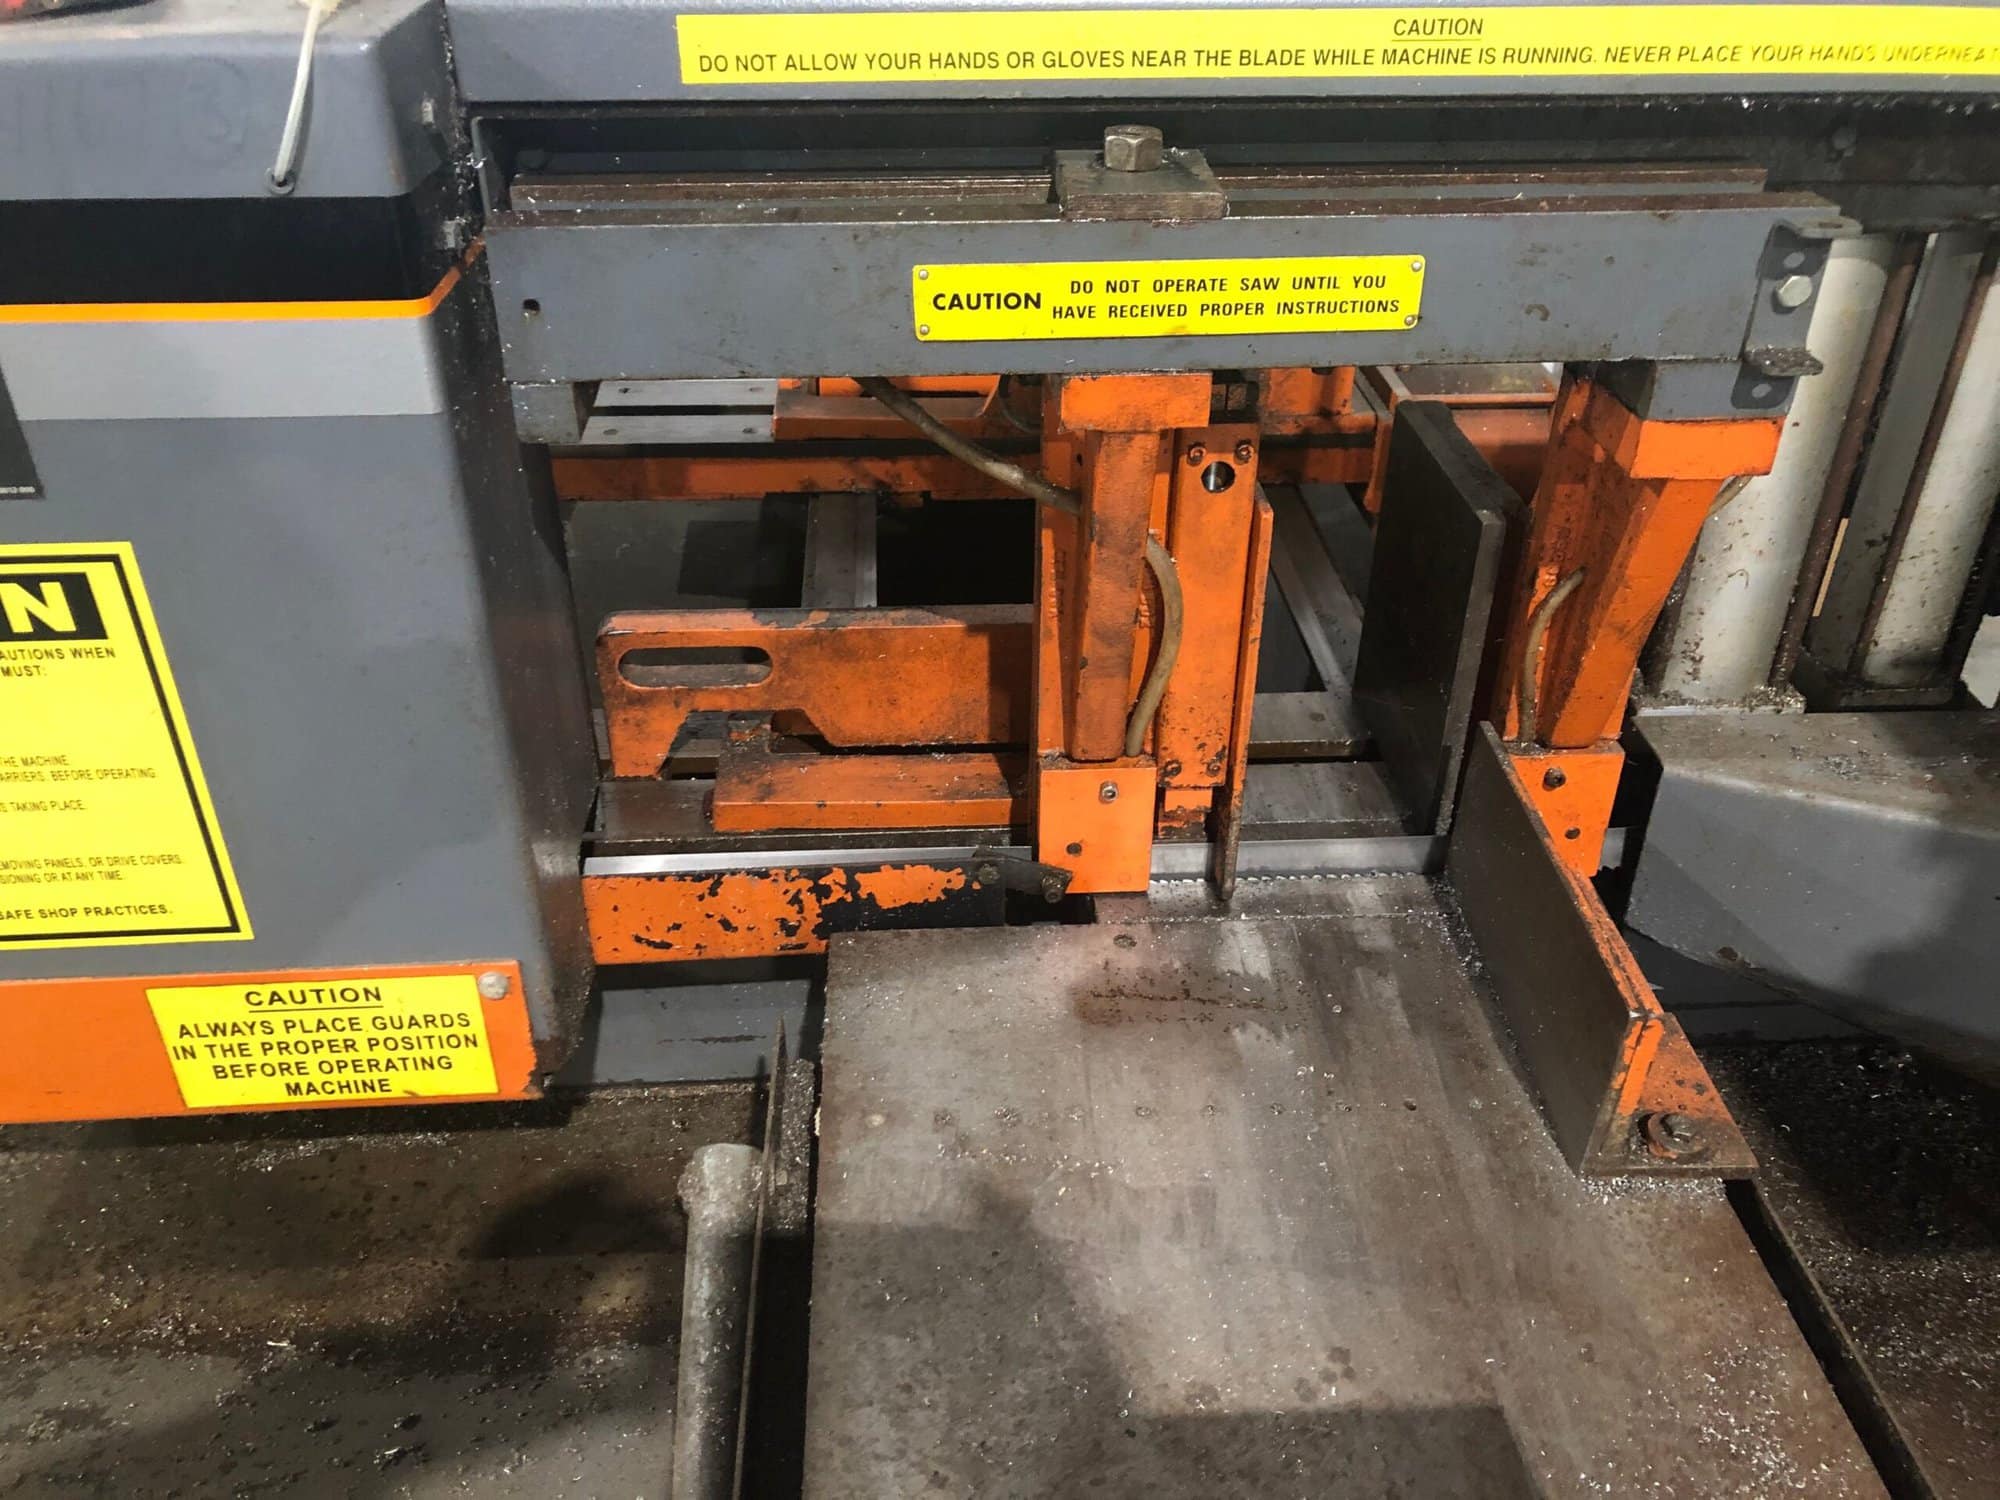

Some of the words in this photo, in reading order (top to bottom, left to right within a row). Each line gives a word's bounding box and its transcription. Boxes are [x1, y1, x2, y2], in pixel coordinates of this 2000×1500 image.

[1394, 18, 1483, 36] CAUTION
[700, 55, 728, 72] DO
[736, 54, 776, 72] NOT
[785, 53, 857, 71] ALLOW
[865, 53, 920, 70] YOUR
[930, 52, 999, 69] HANDS
[1007, 52, 1034, 68] OR
[1042, 50, 1124, 68] GLOVES
[1132, 50, 1186, 67] NEAR
[1194, 50, 1232, 66] THE
[1240, 49, 1305, 66] BLADE
[1314, 49, 1374, 65] WHILE
[1382, 48, 1472, 64] MACHINE
[1479, 48, 1496, 64] IS
[1503, 47, 1597, 64] RUNNING.
[1605, 46, 1671, 63] NEVER
[1677, 46, 1741, 62] PLACE
[1752, 45, 1803, 61] YOUR
[1810, 46, 1875, 61] HANDS
[1071, 281, 1093, 294] DO
[1106, 280, 1140, 293] NOT
[1153, 279, 1227, 292] OPERATE
[1240, 278, 1280, 291] SAW
[1292, 277, 1339, 289] UNTIL
[1353, 276, 1385, 288] YOU
[933, 293, 1041, 310] CAUTION
[1053, 306, 1096, 319] HAVE
[1109, 304, 1187, 318] RECEIVED
[1200, 303, 1264, 316] PROPER
[1277, 300, 1399, 314] INSTRUCTIONS
[70, 647, 115, 658] WHEN
[245, 987, 382, 1006] CAUTION
[179, 1021, 274, 1038] ALWAYS
[283, 1017, 362, 1034] PLACE
[372, 1013, 470, 1030] GUARDS
[173, 1045, 196, 1060] IN
[206, 1043, 252, 1058] THE
[261, 1039, 358, 1056] PROPER
[367, 1034, 478, 1051] POSITION
[213, 1061, 309, 1079] BEFORE
[318, 1056, 452, 1074] OPERATING
[285, 1079, 392, 1096] MACHINE
